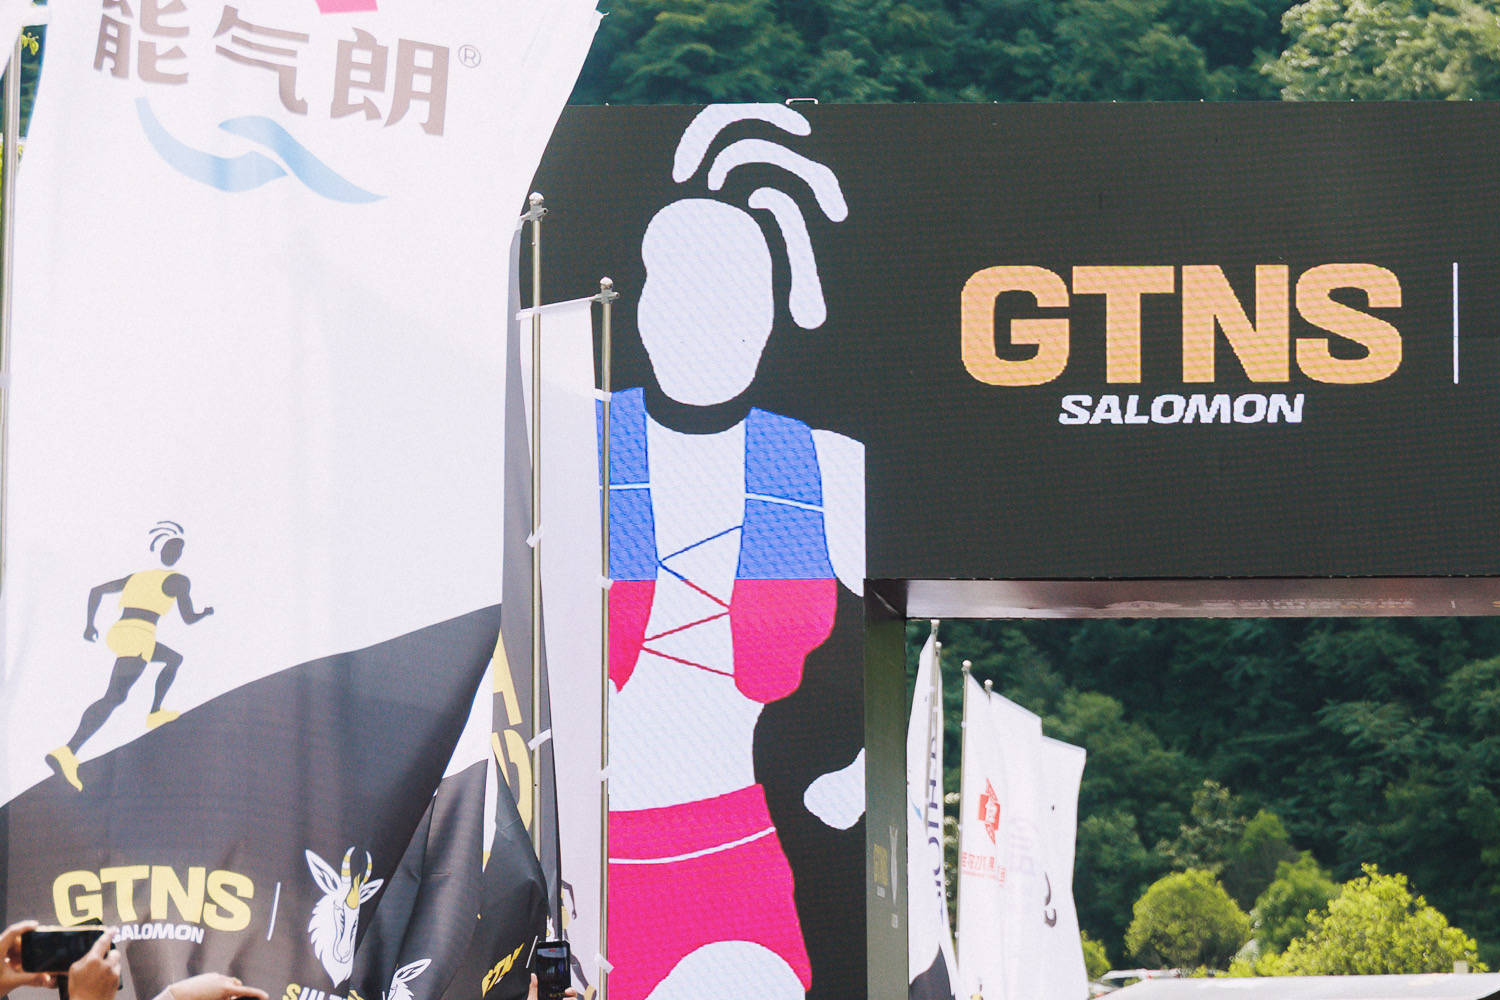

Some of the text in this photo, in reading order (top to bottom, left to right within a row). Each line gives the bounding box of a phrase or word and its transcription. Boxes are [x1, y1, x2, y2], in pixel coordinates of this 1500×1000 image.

[960, 262, 1403, 387] GTNS
[1057, 393, 1305, 425] SALOMON
[52, 866, 255, 933] GTNS
